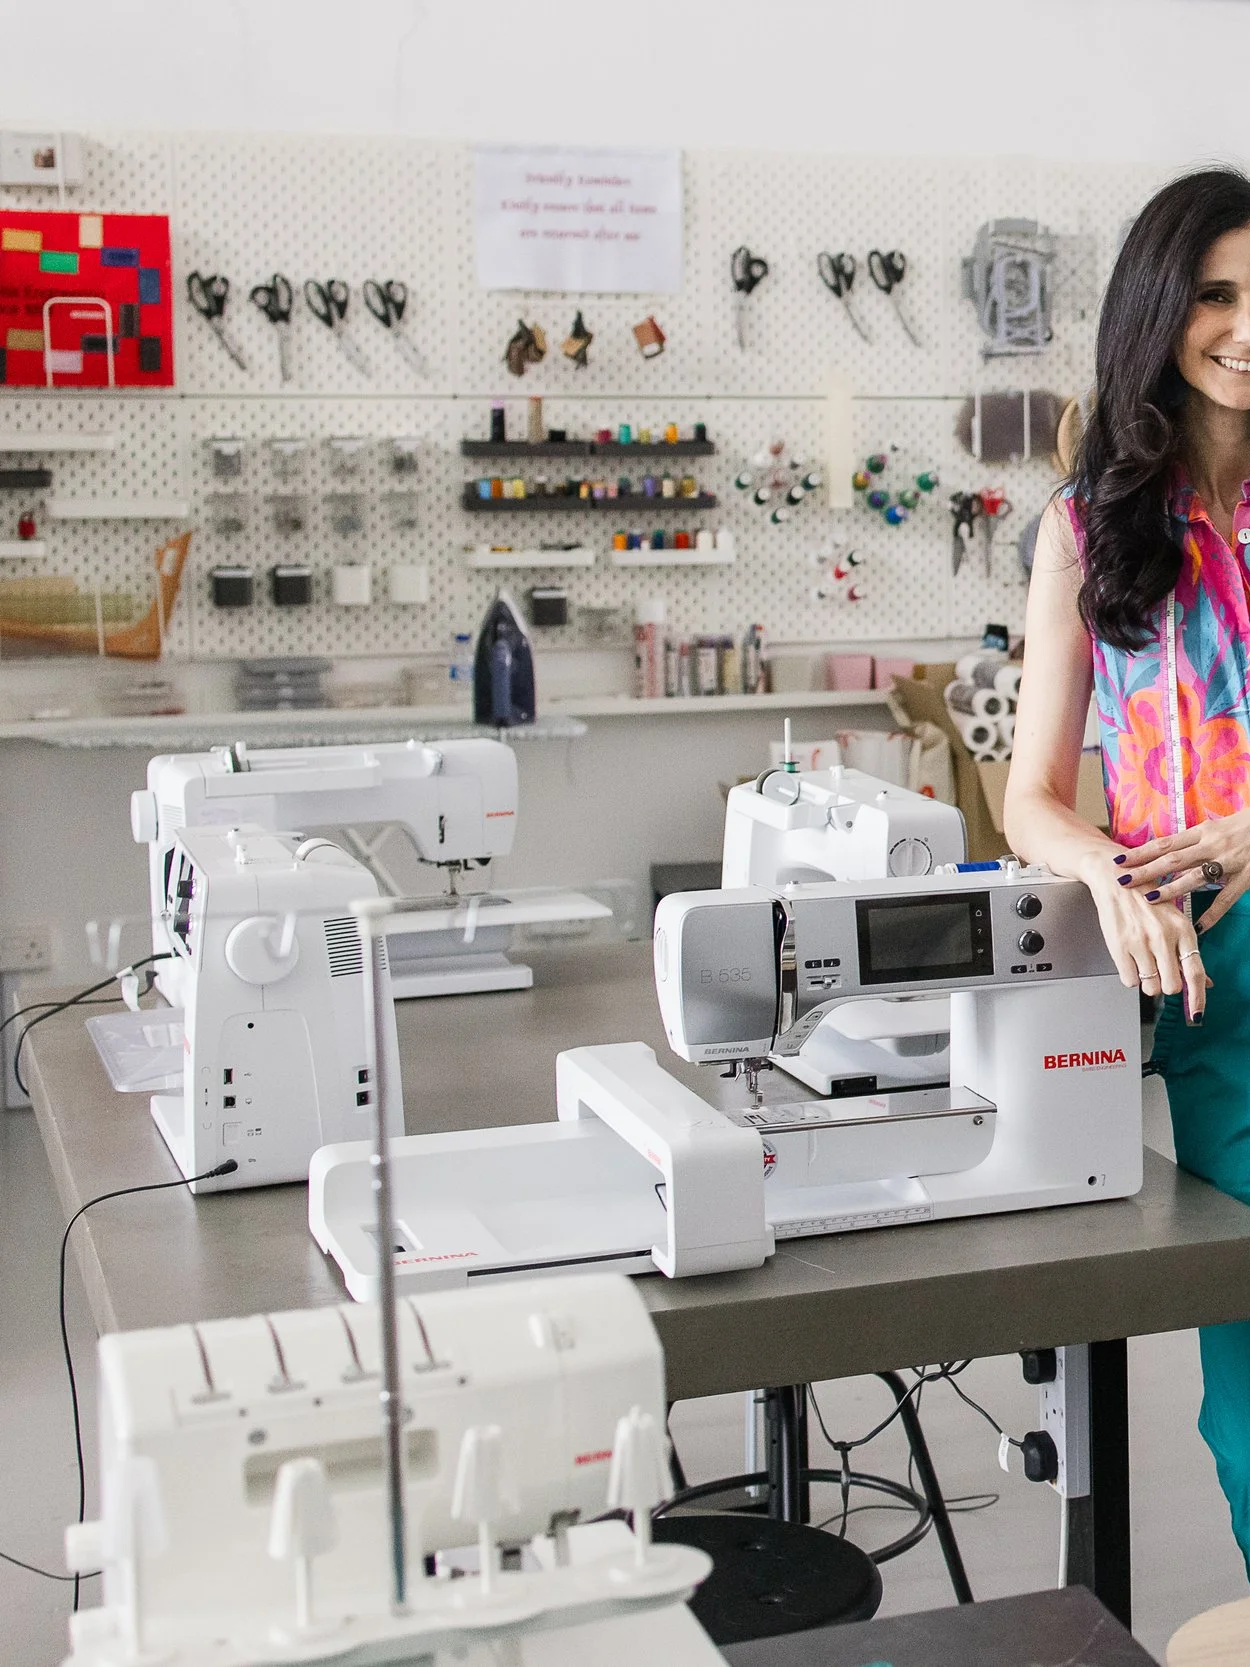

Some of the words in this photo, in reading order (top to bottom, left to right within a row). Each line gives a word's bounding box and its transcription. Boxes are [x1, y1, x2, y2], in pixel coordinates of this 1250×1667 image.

[700, 969, 712, 984] B
[719, 967, 751, 983] 535
[704, 1046, 750, 1055] BERNINA
[1044, 1048, 1126, 1070] BERNINA
